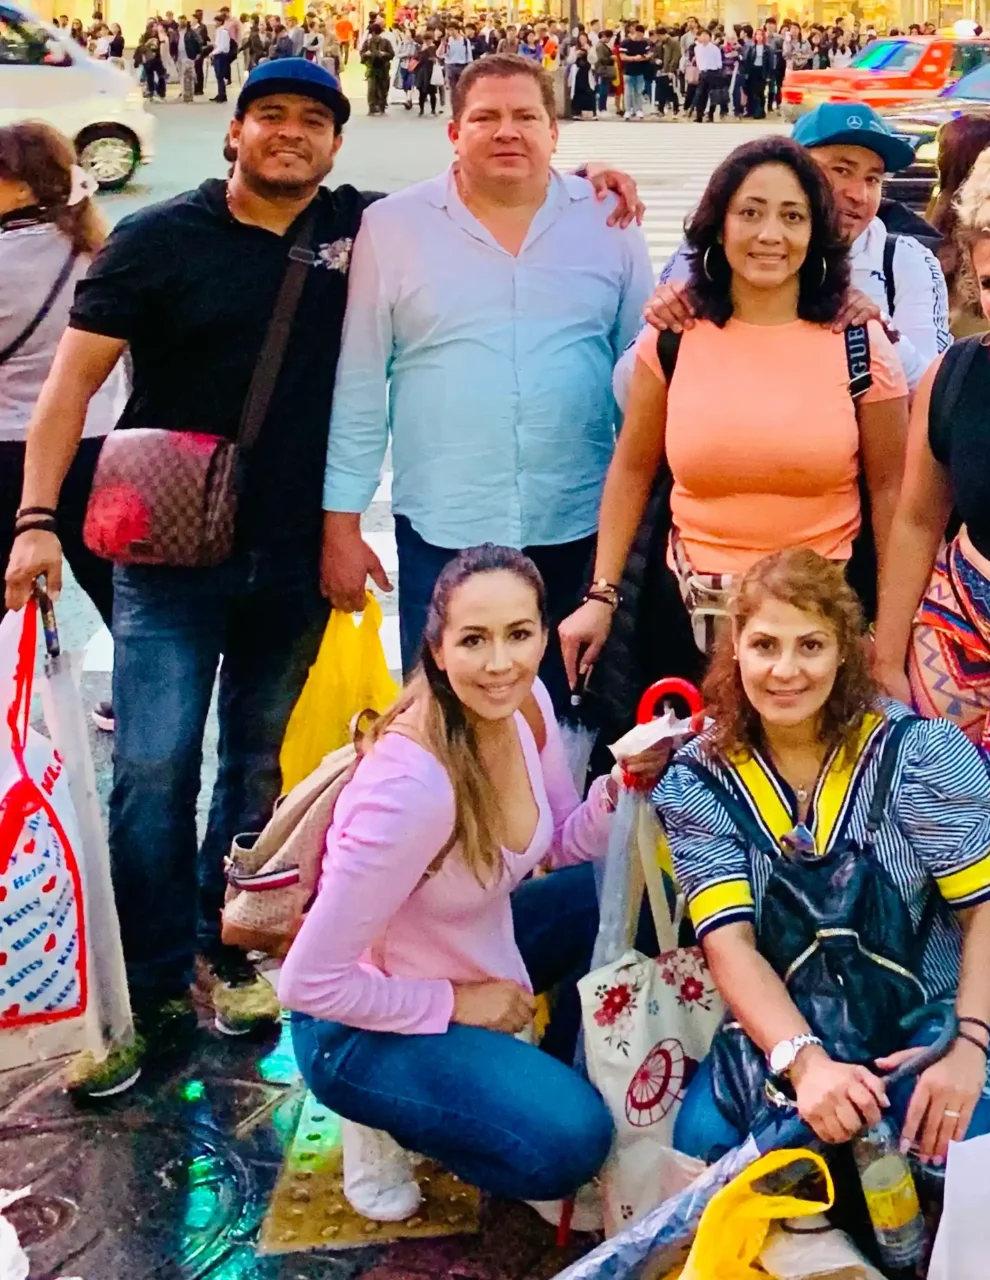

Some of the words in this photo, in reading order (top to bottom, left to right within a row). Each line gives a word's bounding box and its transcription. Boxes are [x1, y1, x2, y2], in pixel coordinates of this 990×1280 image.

[3, 896, 40, 926] Kitty
[11, 921, 48, 951] Hello
[6, 958, 43, 988] Kitty
[24, 969, 59, 1002] Hello
